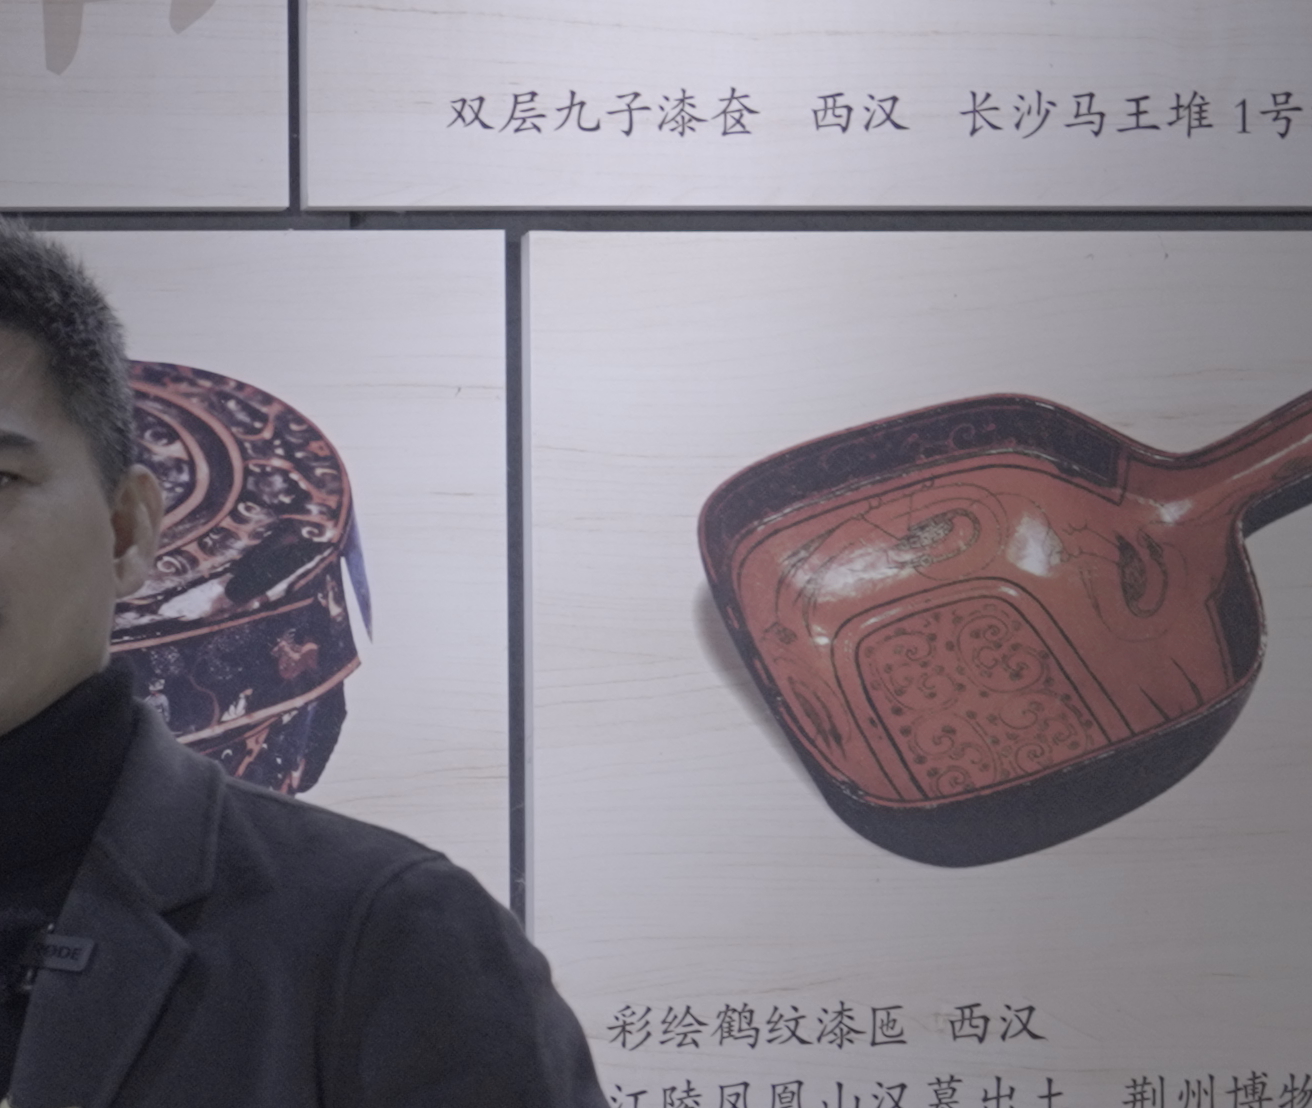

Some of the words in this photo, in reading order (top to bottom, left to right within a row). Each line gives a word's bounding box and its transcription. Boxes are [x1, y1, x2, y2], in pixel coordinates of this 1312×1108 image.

[446, 86, 761, 138] 双层九子漆奁
[811, 91, 911, 135] 西汉
[606, 1000, 908, 1052] 彩绘鹤纹漆匜
[947, 1002, 1047, 1045] 西汉
